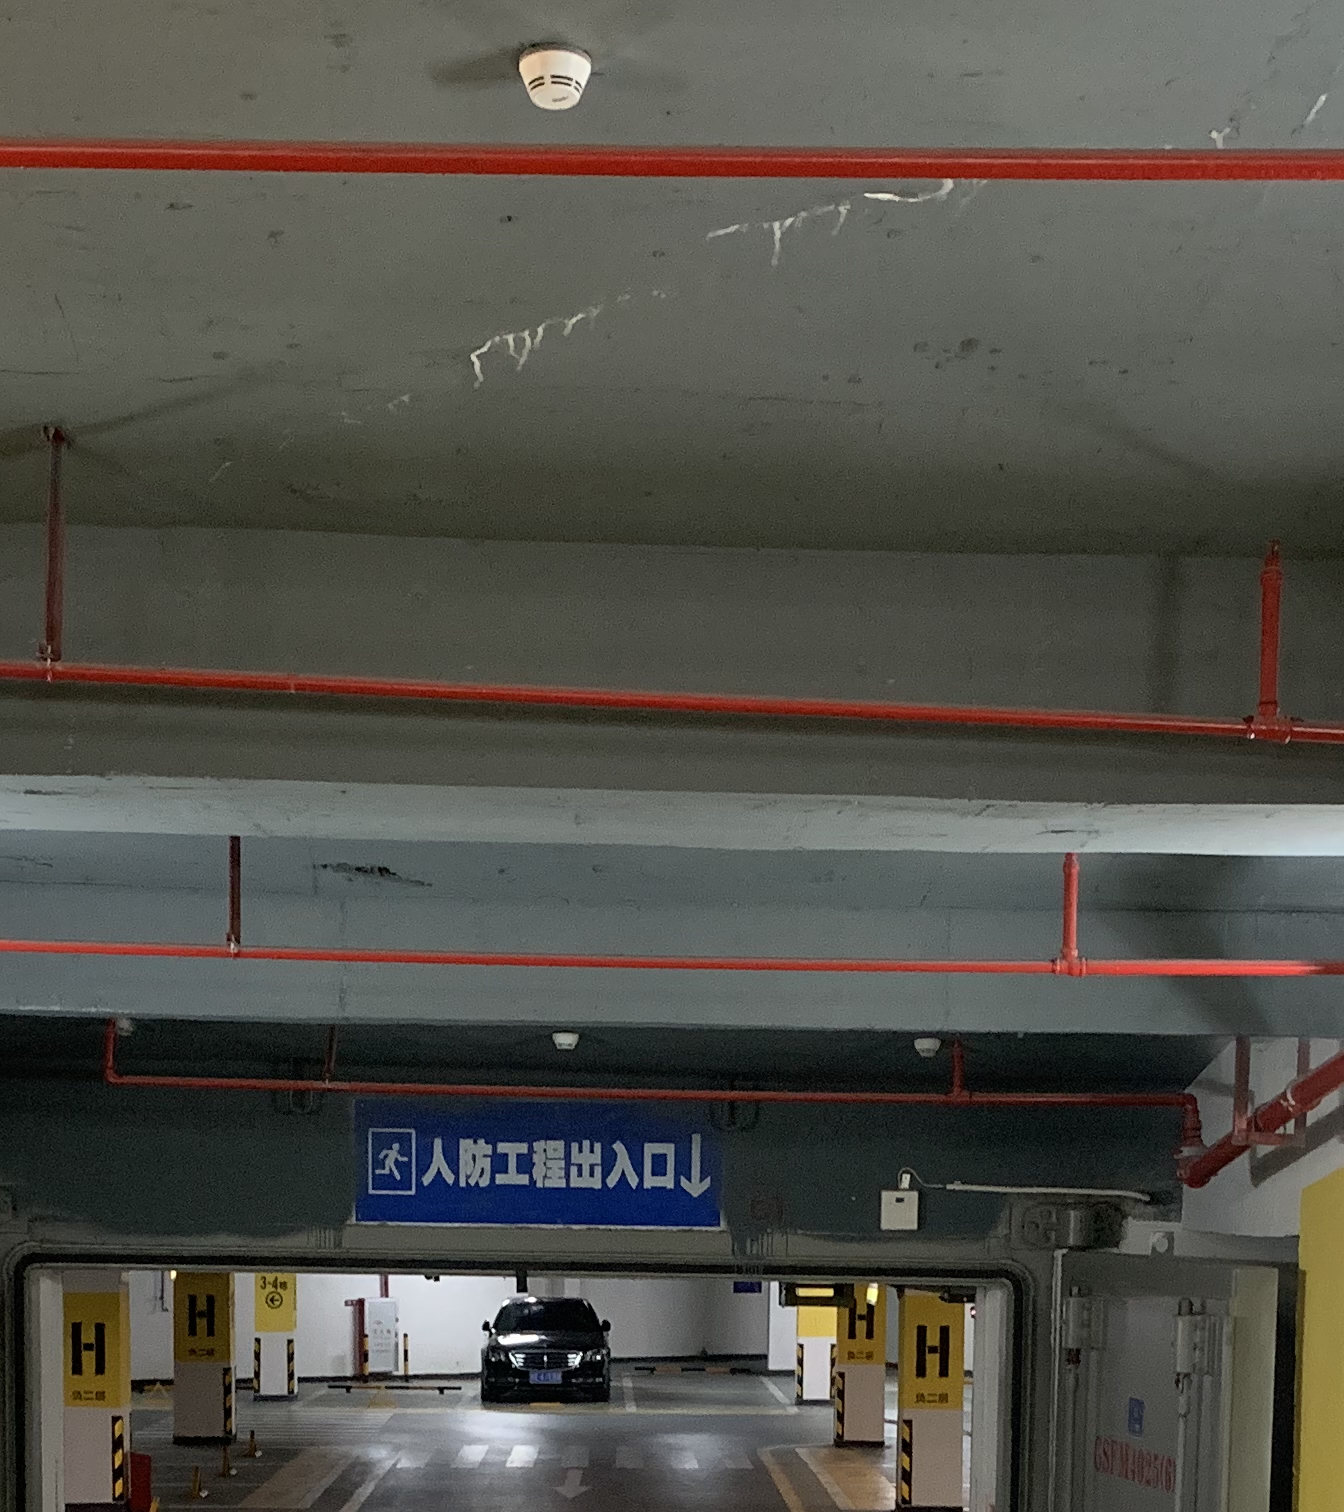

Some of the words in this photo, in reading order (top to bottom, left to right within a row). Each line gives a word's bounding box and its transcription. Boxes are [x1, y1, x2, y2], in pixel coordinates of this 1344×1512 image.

[421, 1136, 676, 1190] 人防工程出入口
[187, 1294, 215, 1337] H
[847, 1298, 875, 1340] H
[71, 1321, 106, 1376] H
[916, 1325, 950, 1378] H
